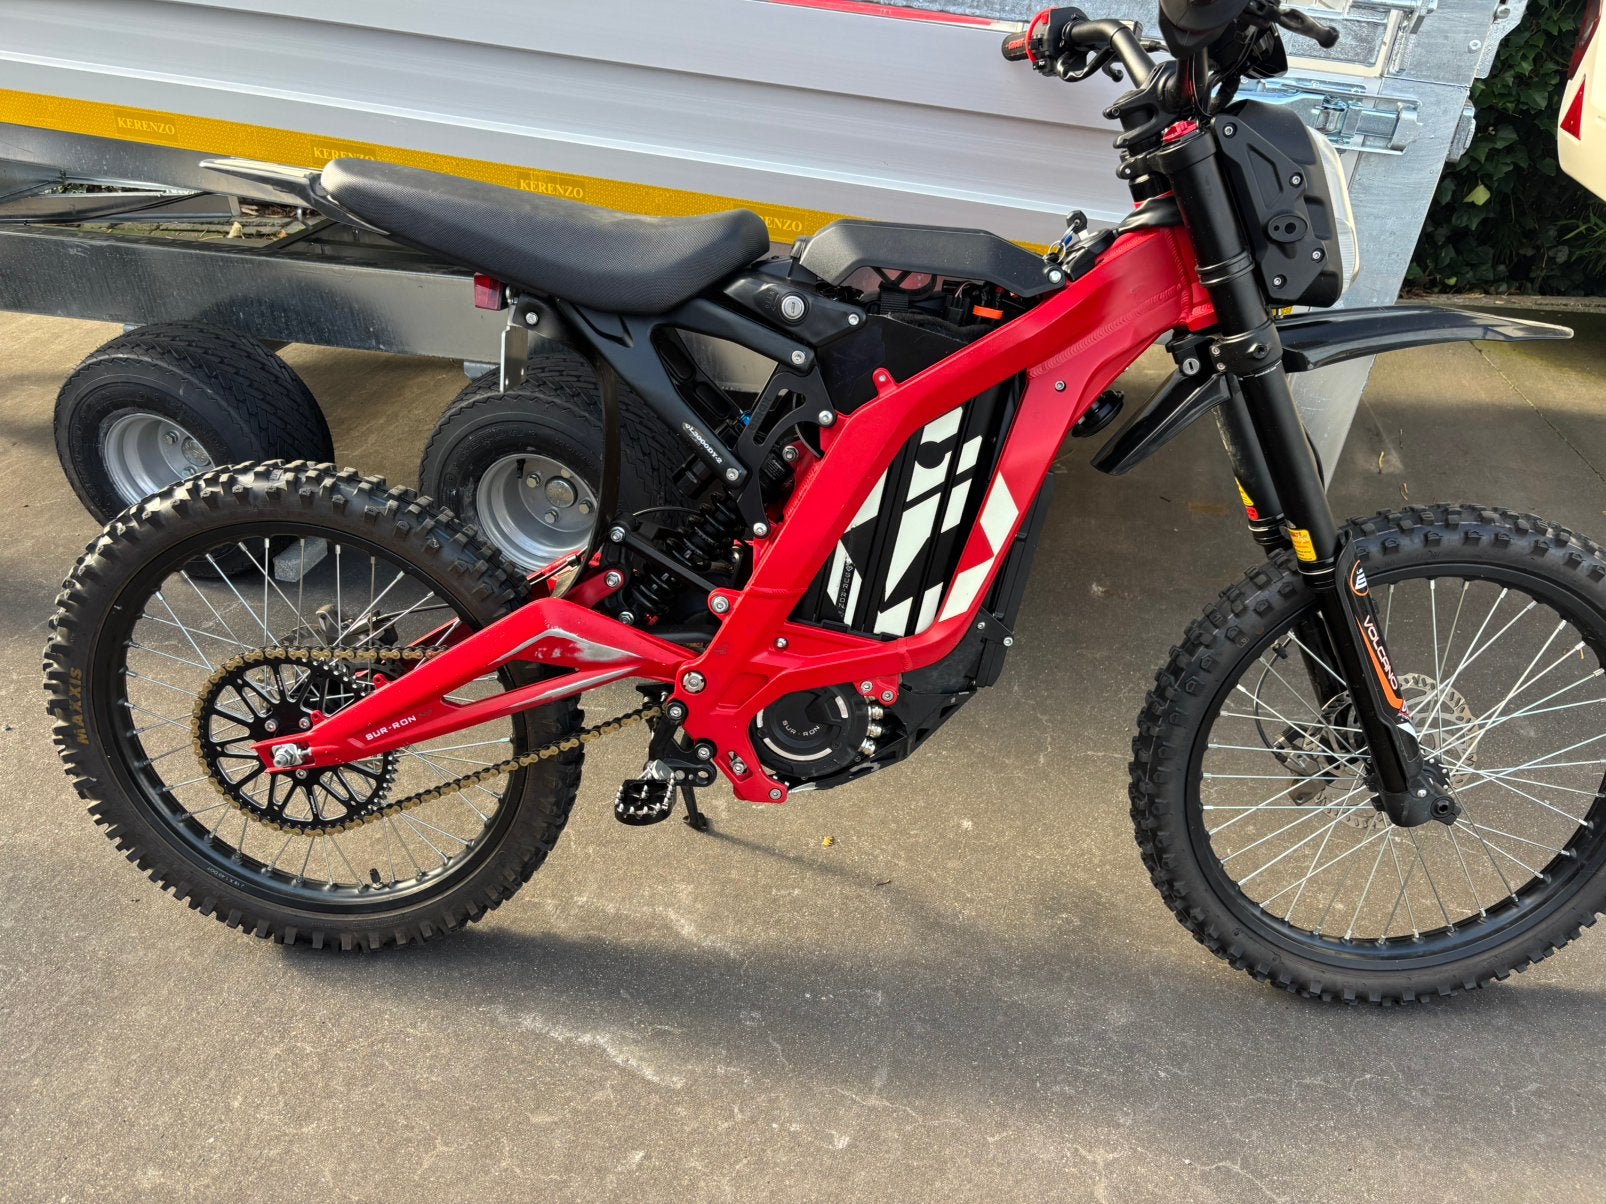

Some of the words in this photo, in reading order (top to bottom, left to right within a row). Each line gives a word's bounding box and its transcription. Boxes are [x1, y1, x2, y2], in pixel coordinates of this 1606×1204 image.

[116, 115, 176, 136] KERENZO
[518, 178, 585, 199] KERENZO
[762, 215, 803, 232] ENZO
[1363, 614, 1398, 691] VOLCANO
[68, 667, 90, 746] MAXXIS
[365, 714, 417, 741] SUR-RON
